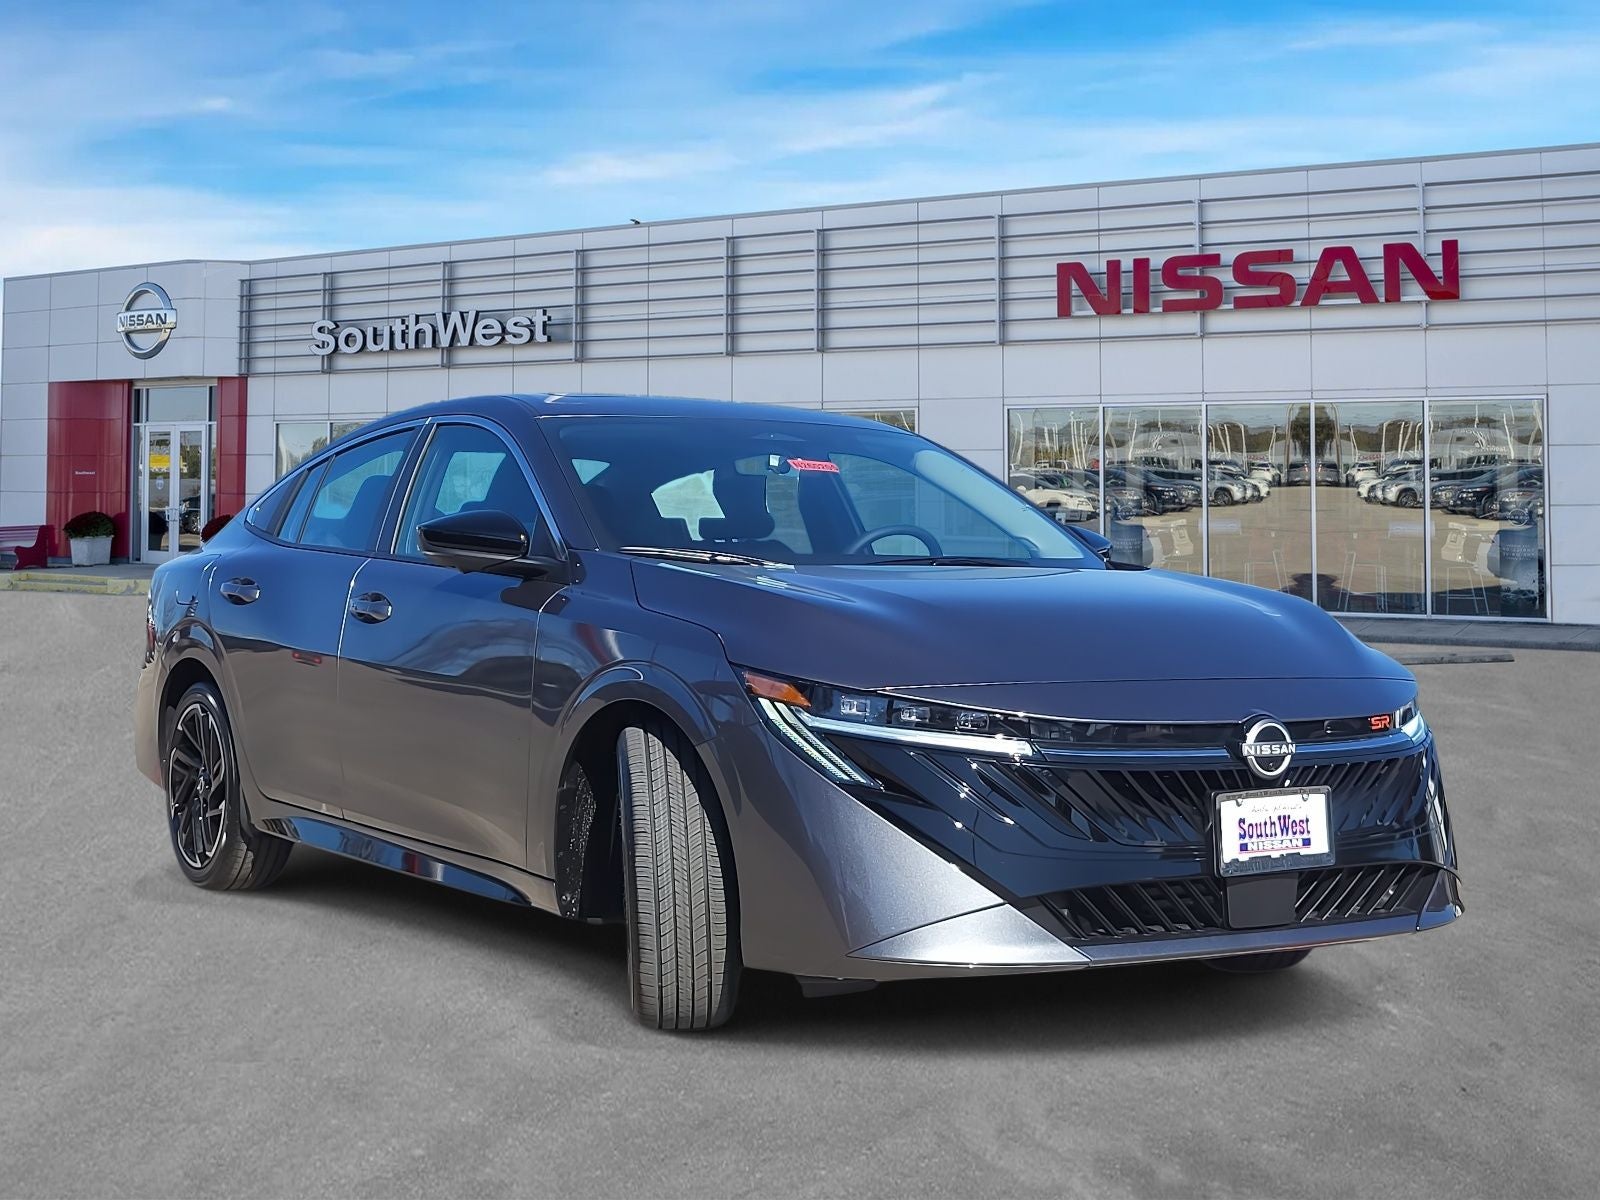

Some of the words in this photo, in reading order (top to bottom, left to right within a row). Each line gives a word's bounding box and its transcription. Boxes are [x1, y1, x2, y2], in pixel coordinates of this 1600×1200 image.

[1056, 239, 1461, 319] NISSAN
[119, 312, 167, 328] NISSAN
[309, 309, 549, 355] SouthWest
[1370, 716, 1391, 729] SR
[1244, 743, 1296, 755] NISSAN
[1238, 814, 1311, 840] SouthWest
[1247, 838, 1303, 851] NISSAN
